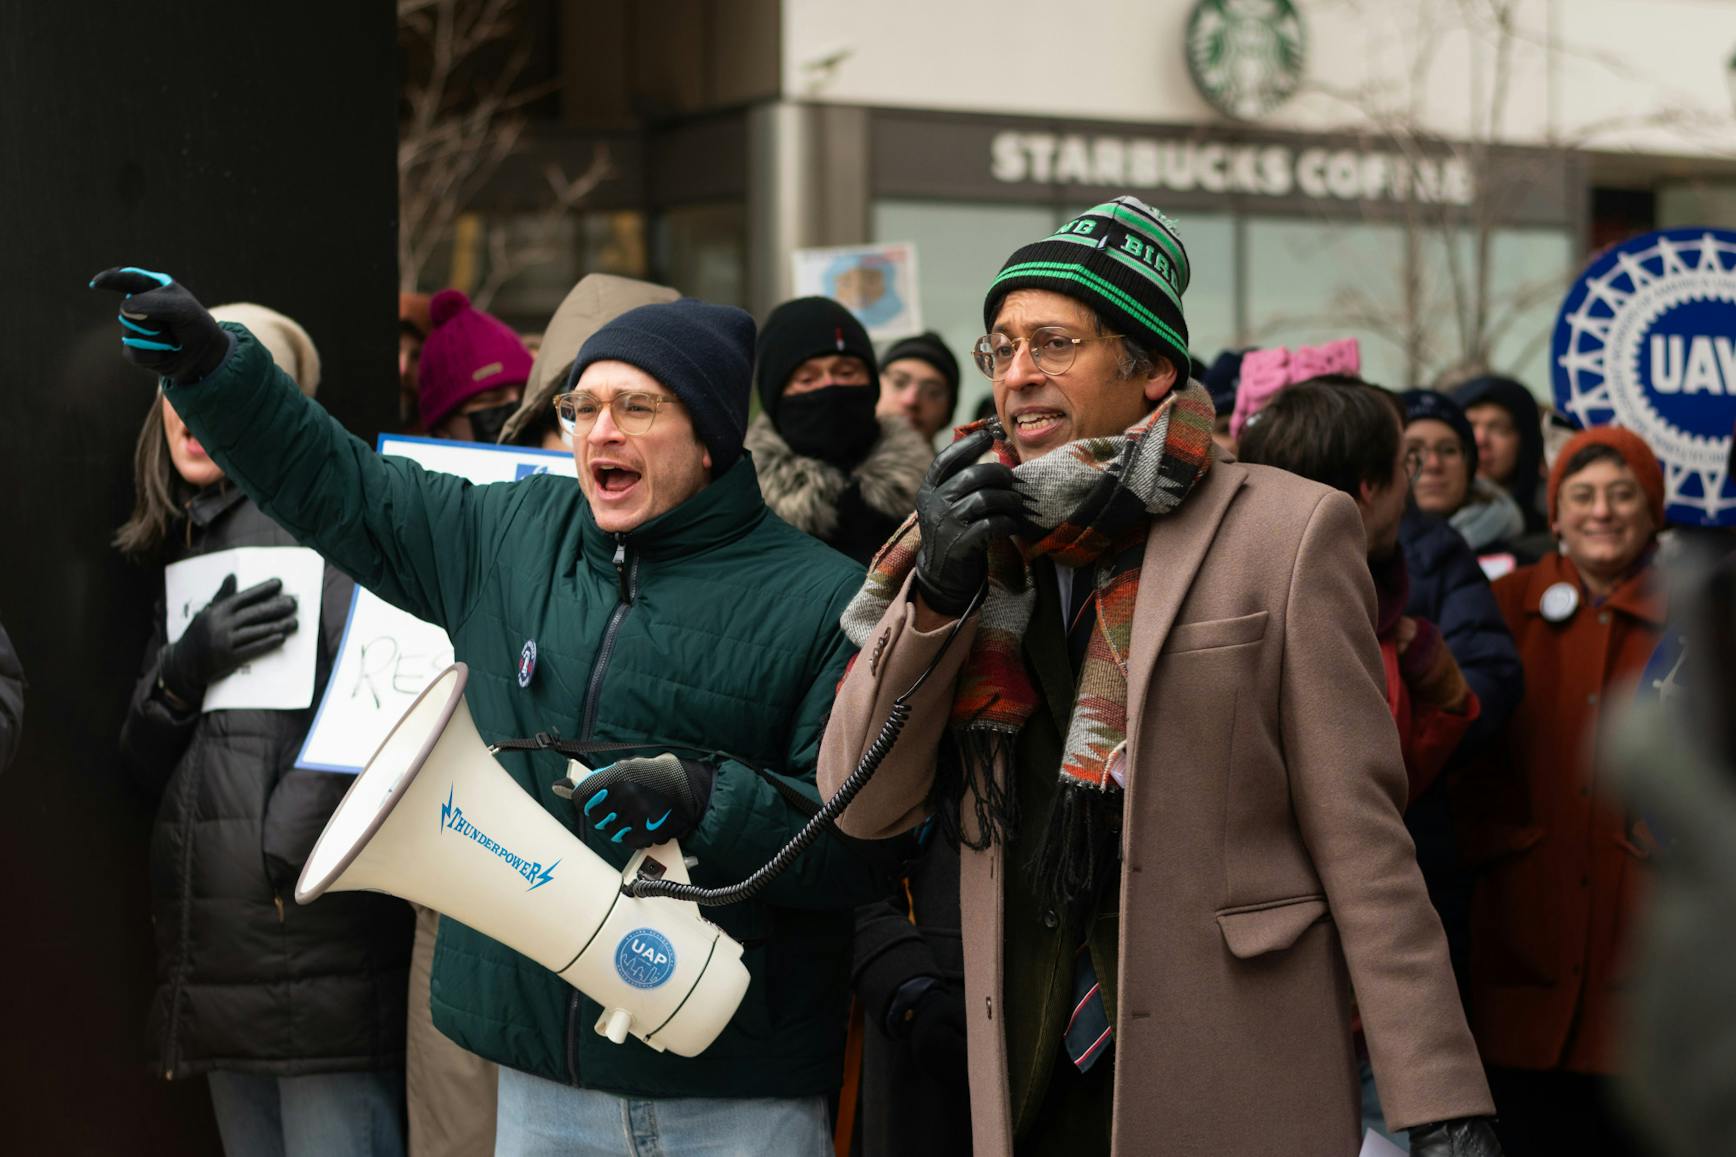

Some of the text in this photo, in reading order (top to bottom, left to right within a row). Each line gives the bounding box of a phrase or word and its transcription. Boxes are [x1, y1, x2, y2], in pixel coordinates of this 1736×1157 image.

[991, 132, 1294, 195] STARBUCKS
[446, 806, 542, 885] THUNDERPOWER
[631, 938, 668, 964] UAP
